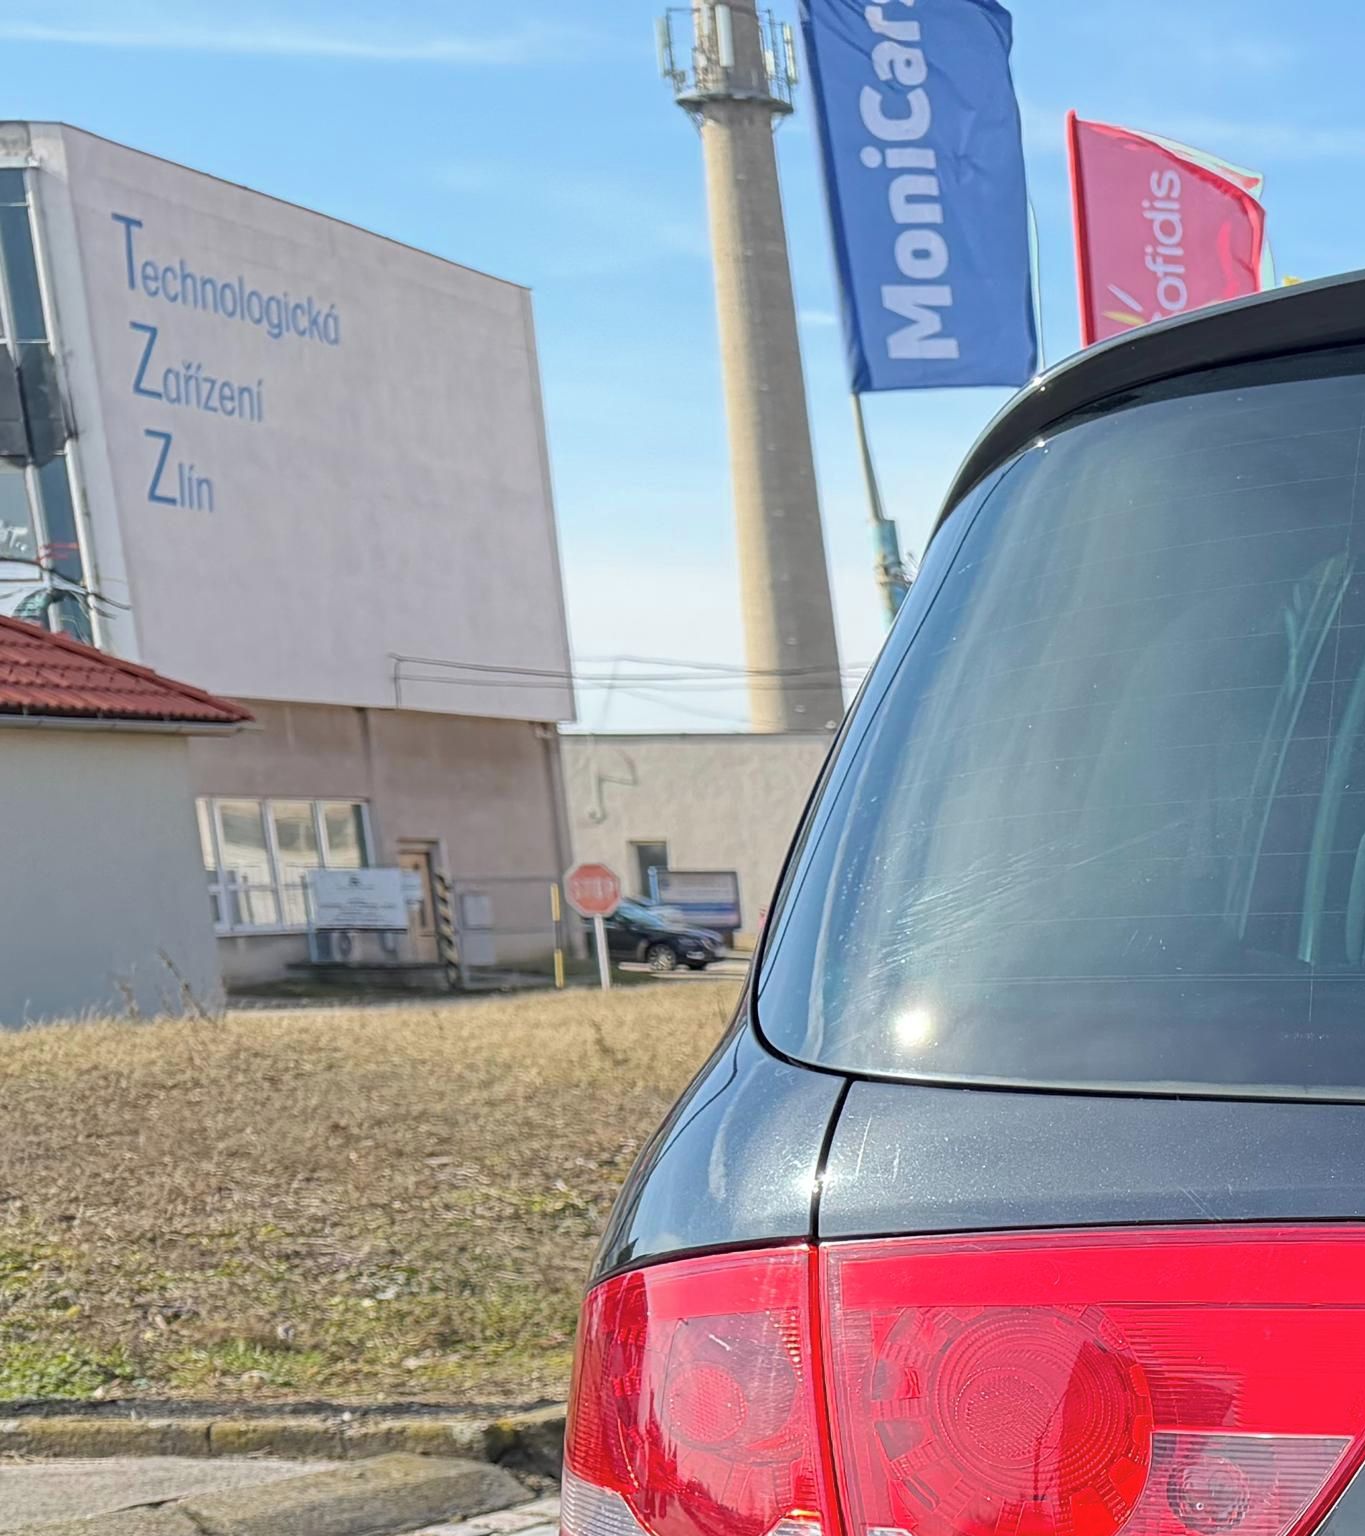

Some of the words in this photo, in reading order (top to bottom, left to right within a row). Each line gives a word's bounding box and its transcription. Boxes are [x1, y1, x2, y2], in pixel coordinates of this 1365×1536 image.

[859, 0, 960, 360] MoniCar
[111, 212, 340, 346] Technologická
[129, 320, 264, 423] Zařízení
[144, 428, 214, 513] Zlín
